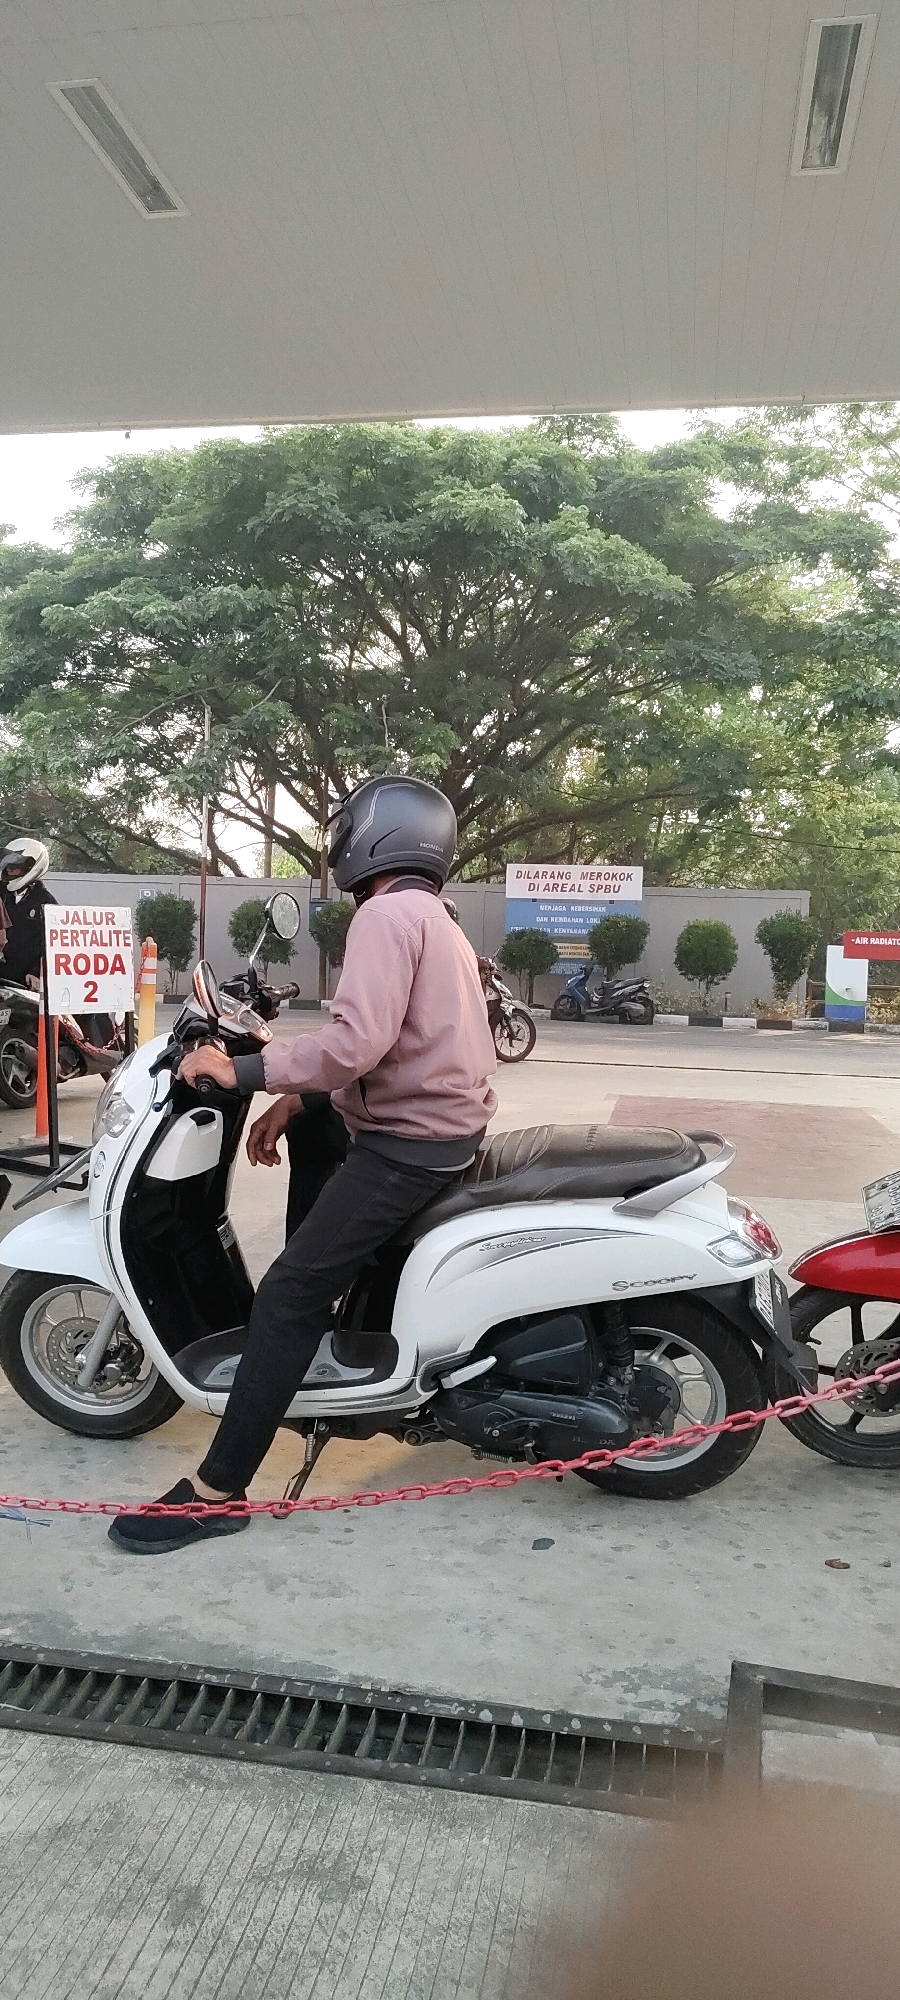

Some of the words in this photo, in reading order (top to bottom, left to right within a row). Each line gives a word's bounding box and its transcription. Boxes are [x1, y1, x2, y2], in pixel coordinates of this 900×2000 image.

[419, 842, 444, 853] HONDA
[515, 870, 572, 880] DILARANG
[580, 871, 635, 881] MEROKOK
[527, 882, 540, 892] DI
[542, 882, 584, 892] AREAL
[588, 883, 622, 894] SPBU
[539, 904, 567, 912] MENJAGA
[570, 905, 607, 913] KEBERSIHAN
[60, 909, 116, 926] JALUR
[49, 928, 132, 948] PERTALITE
[54, 953, 127, 976] RODA
[83, 980, 99, 1003] 2
